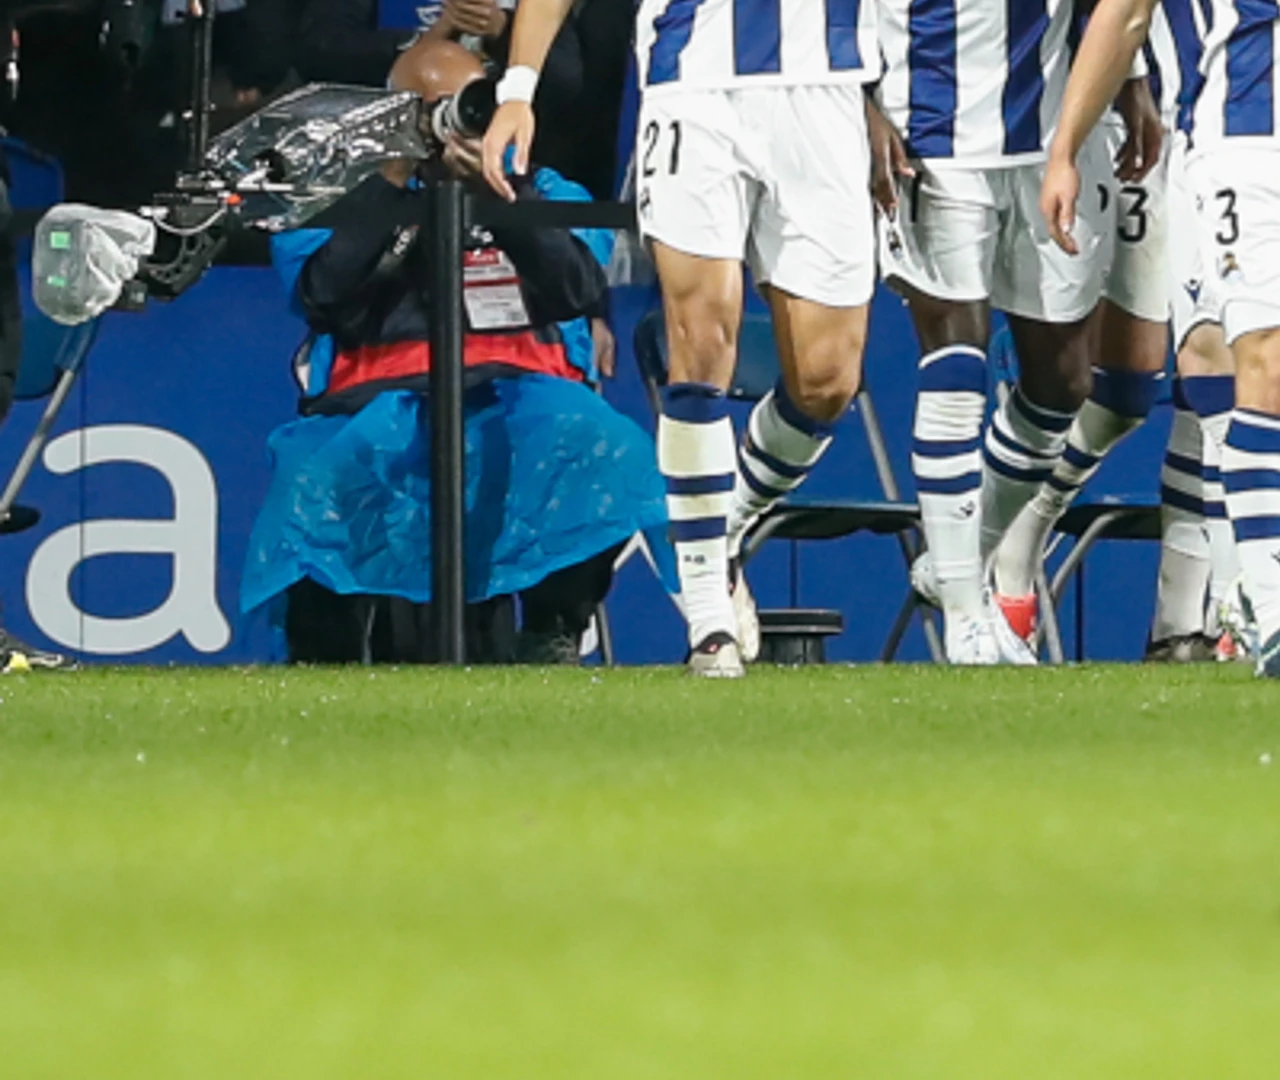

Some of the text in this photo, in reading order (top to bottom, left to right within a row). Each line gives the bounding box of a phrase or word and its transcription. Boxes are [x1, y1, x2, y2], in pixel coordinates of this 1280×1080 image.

[643, 119, 681, 178] 21
[1214, 187, 1240, 245] 3
[25, 423, 232, 655] a
